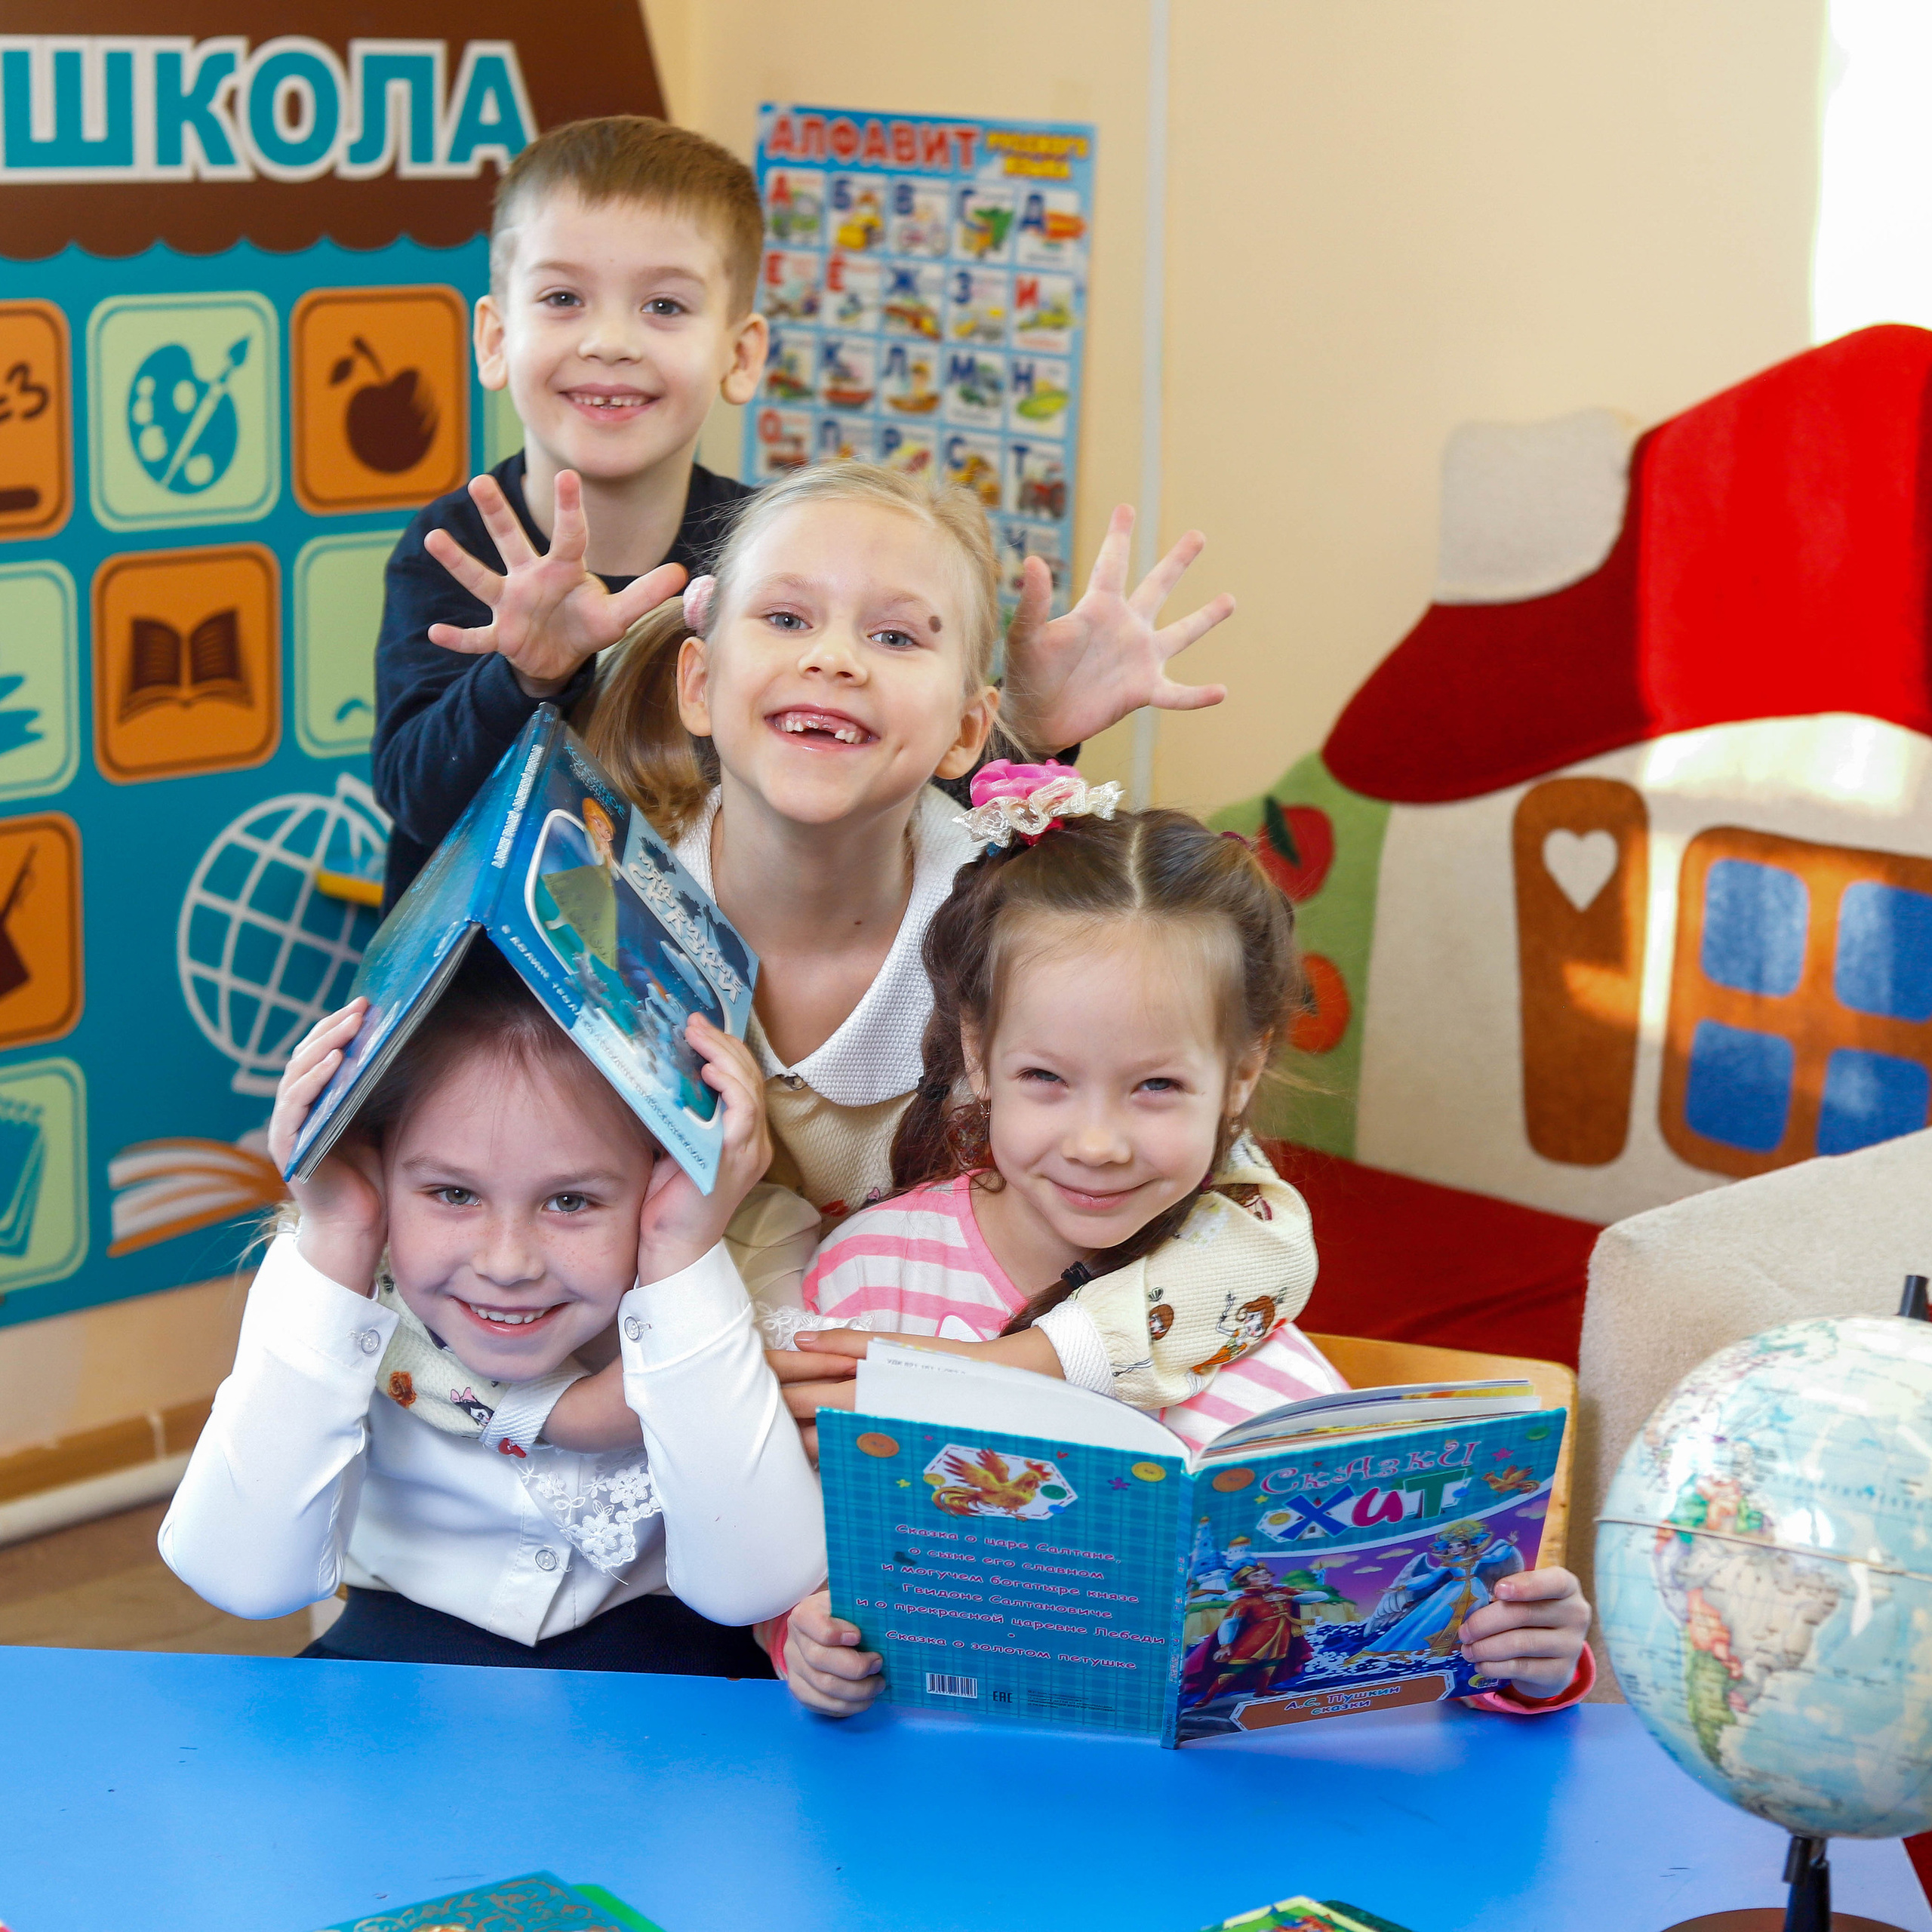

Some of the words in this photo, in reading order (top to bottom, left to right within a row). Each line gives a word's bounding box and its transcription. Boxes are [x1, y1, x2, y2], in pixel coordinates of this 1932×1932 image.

[0, 36, 536, 181] ШКОЛА
[765, 115, 980, 176] АЛФАВИТ
[769, 173, 792, 205] А
[832, 178, 852, 210] Б
[765, 251, 784, 286] Е
[1015, 274, 1039, 308] И
[949, 354, 976, 383] М
[1011, 361, 1035, 392] Н
[564, 742, 626, 820] ХОЛОДНОЕ
[628, 863, 740, 1004] СКАЗКИ
[895, 1524, 958, 1541] Сказка
[965, 1534, 977, 1543] о
[983, 1537, 1029, 1551] царе
[1036, 1543, 1122, 1564] Салтане,
[908, 1546, 921, 1556] о
[928, 1549, 976, 1563] сыне
[983, 1556, 1016, 1568] его
[1022, 1561, 1105, 1580] славном
[881, 1561, 894, 1573] и
[901, 1564, 983, 1584] могучем
[990, 1576, 1081, 1597] богатыре
[1087, 1587, 1140, 1605] князе
[902, 1582, 983, 1604] Гвидоне
[989, 1593, 1114, 1620] Салтановиче
[855, 1598, 869, 1608] и
[875, 1600, 888, 1609] о
[894, 1601, 1004, 1624] прекрасной
[1011, 1617, 1088, 1635] царевне
[1094, 1626, 1165, 1645] Лебеди
[885, 1629, 946, 1647] Сказка
[952, 1639, 964, 1649] о
[971, 1642, 1051, 1660] золотом
[1057, 1652, 1138, 1672] петушке
[1284, 1698, 1321, 1711] А.С.
[1327, 1685, 1401, 1704] Пушкин
[1311, 1700, 1371, 1715] сказки
